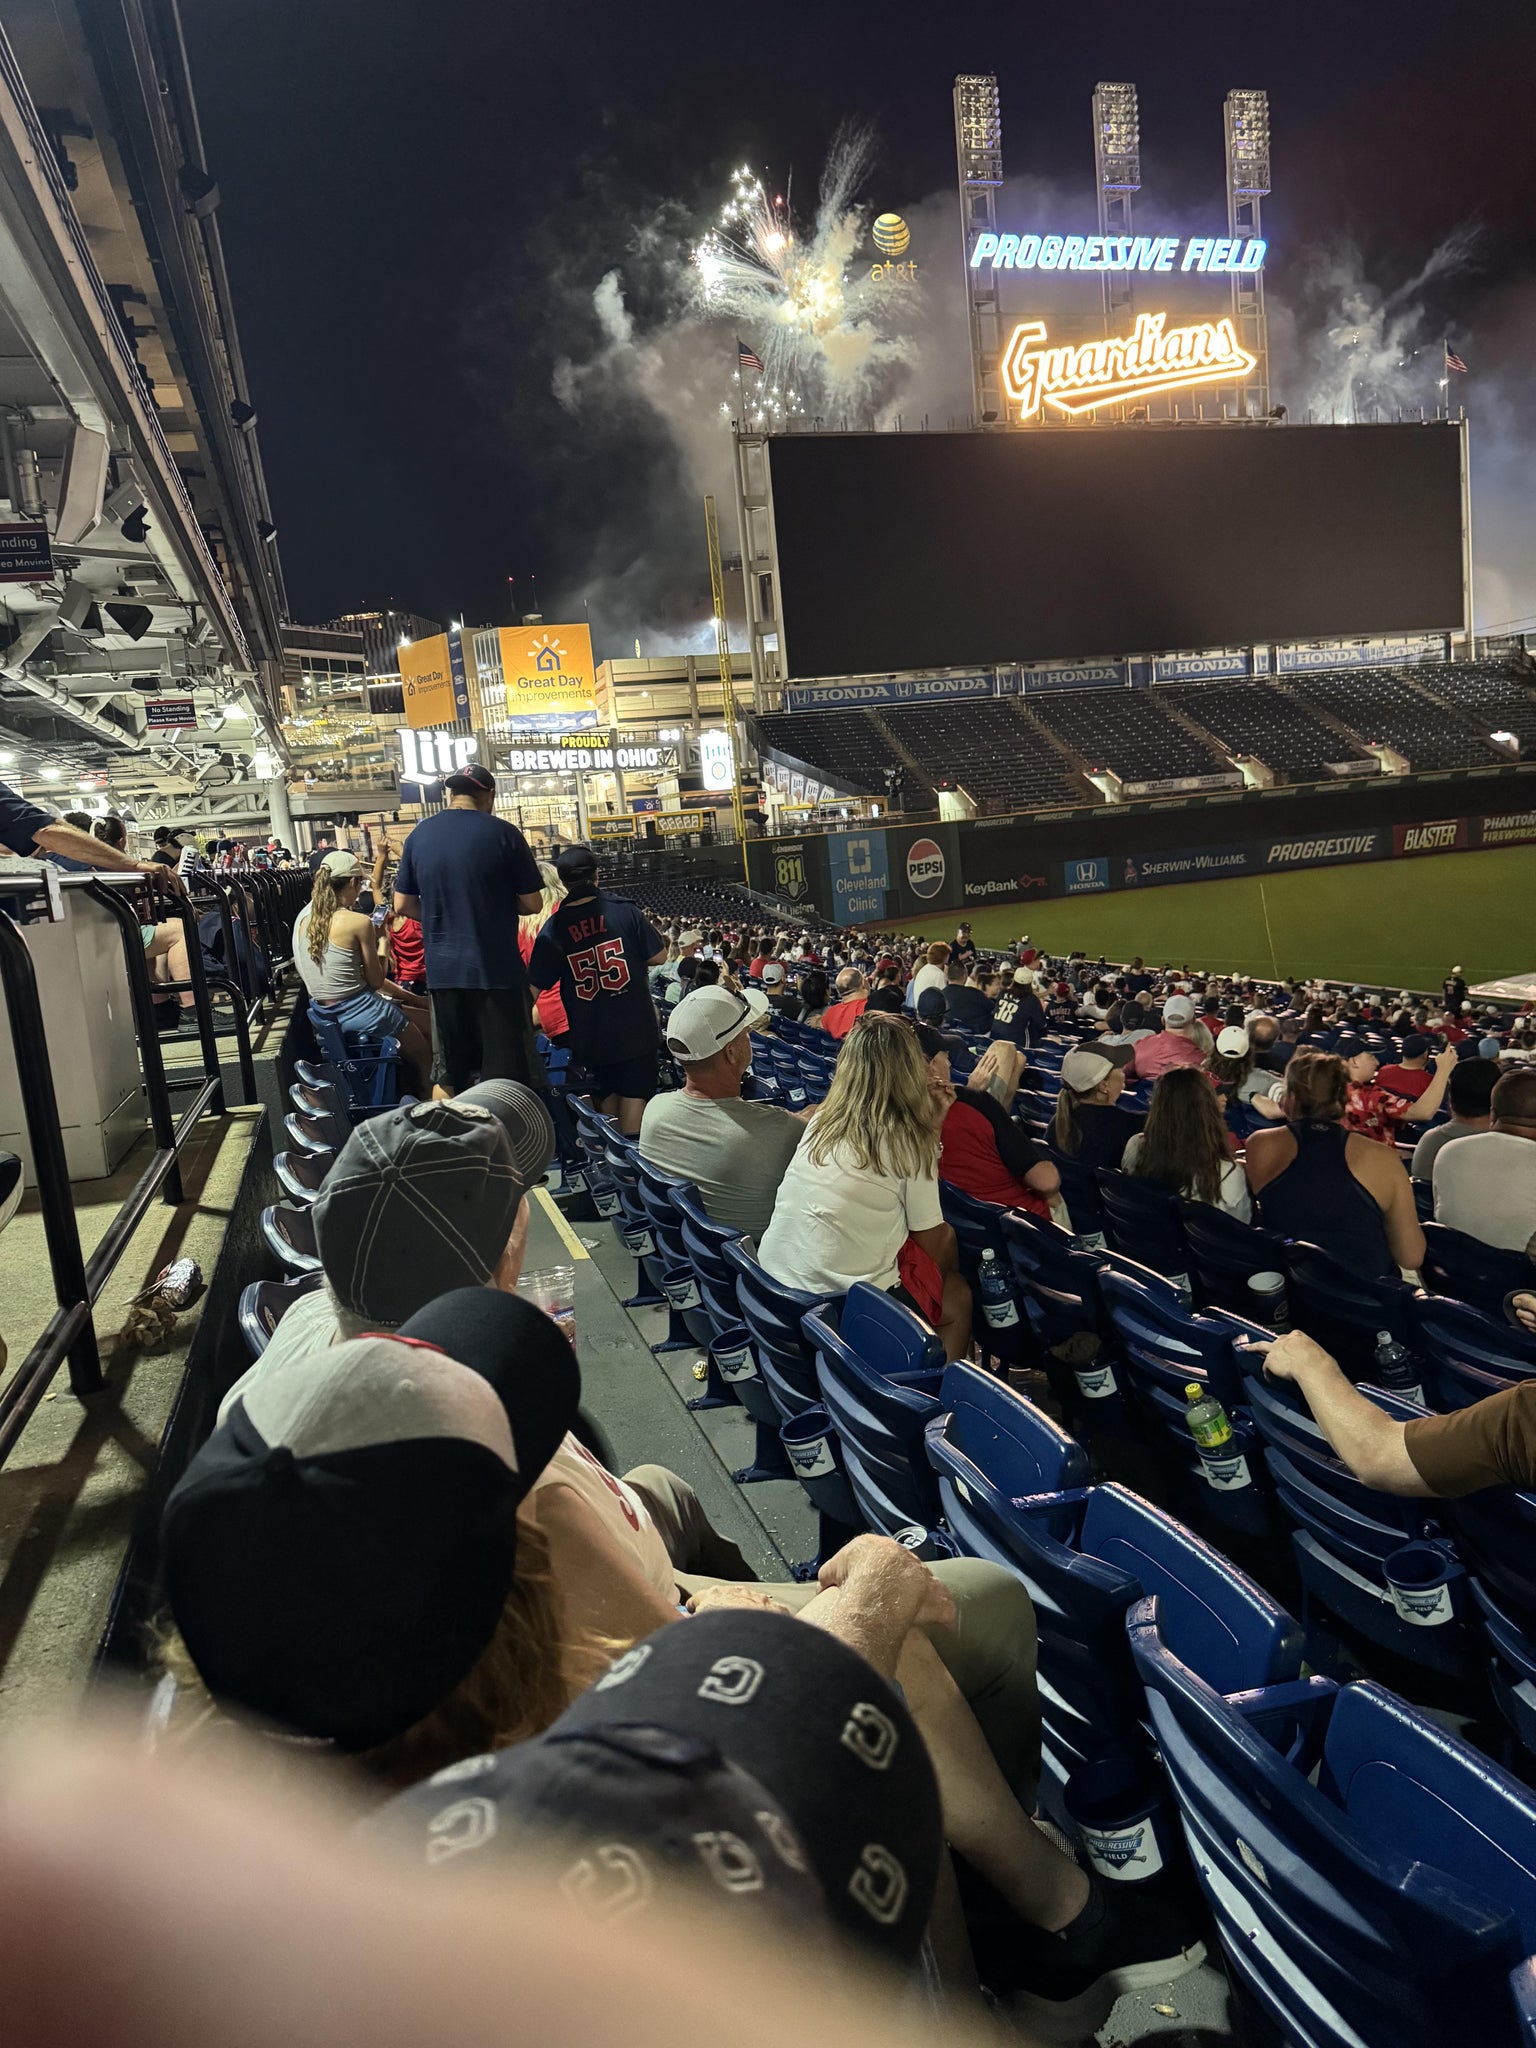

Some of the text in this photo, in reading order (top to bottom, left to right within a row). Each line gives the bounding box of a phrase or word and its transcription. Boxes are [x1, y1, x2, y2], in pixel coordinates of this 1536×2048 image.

[969, 233, 1268, 273] PROGRESSIVE FIELD
[870, 259, 918, 282] at&t
[1002, 312, 1257, 419] Guardians
[1297, 649, 1361, 665] HONDA
[1175, 658, 1245, 674] HONDA
[417, 671, 443, 685] Great Day
[517, 674, 583, 688] Great Day
[1046, 667, 1120, 685] HONDA
[812, 686, 890, 701] HONDA
[913, 678, 989, 694] HONDA
[162, 705, 190, 713] Standing
[561, 735, 610, 749] PROUDLY
[395, 728, 478, 785] Lite
[510, 748, 658, 770] BREWED IN OHIO
[1404, 824, 1457, 850] BLASTER
[1267, 834, 1377, 863] PROGRESSIVE
[777, 857, 802, 885] 811
[909, 860, 943, 877] PEPSI
[836, 874, 887, 893] Cleveland
[965, 879, 1019, 896] KeyBank
[1069, 881, 1105, 890] HONDA
[848, 896, 878, 912] Clinic
[568, 914, 607, 943] BELL
[567, 937, 631, 1001] 55
[1088, 1839, 1138, 1849] PROGRESSIVE
[1103, 1852, 1128, 1860] FIELD
